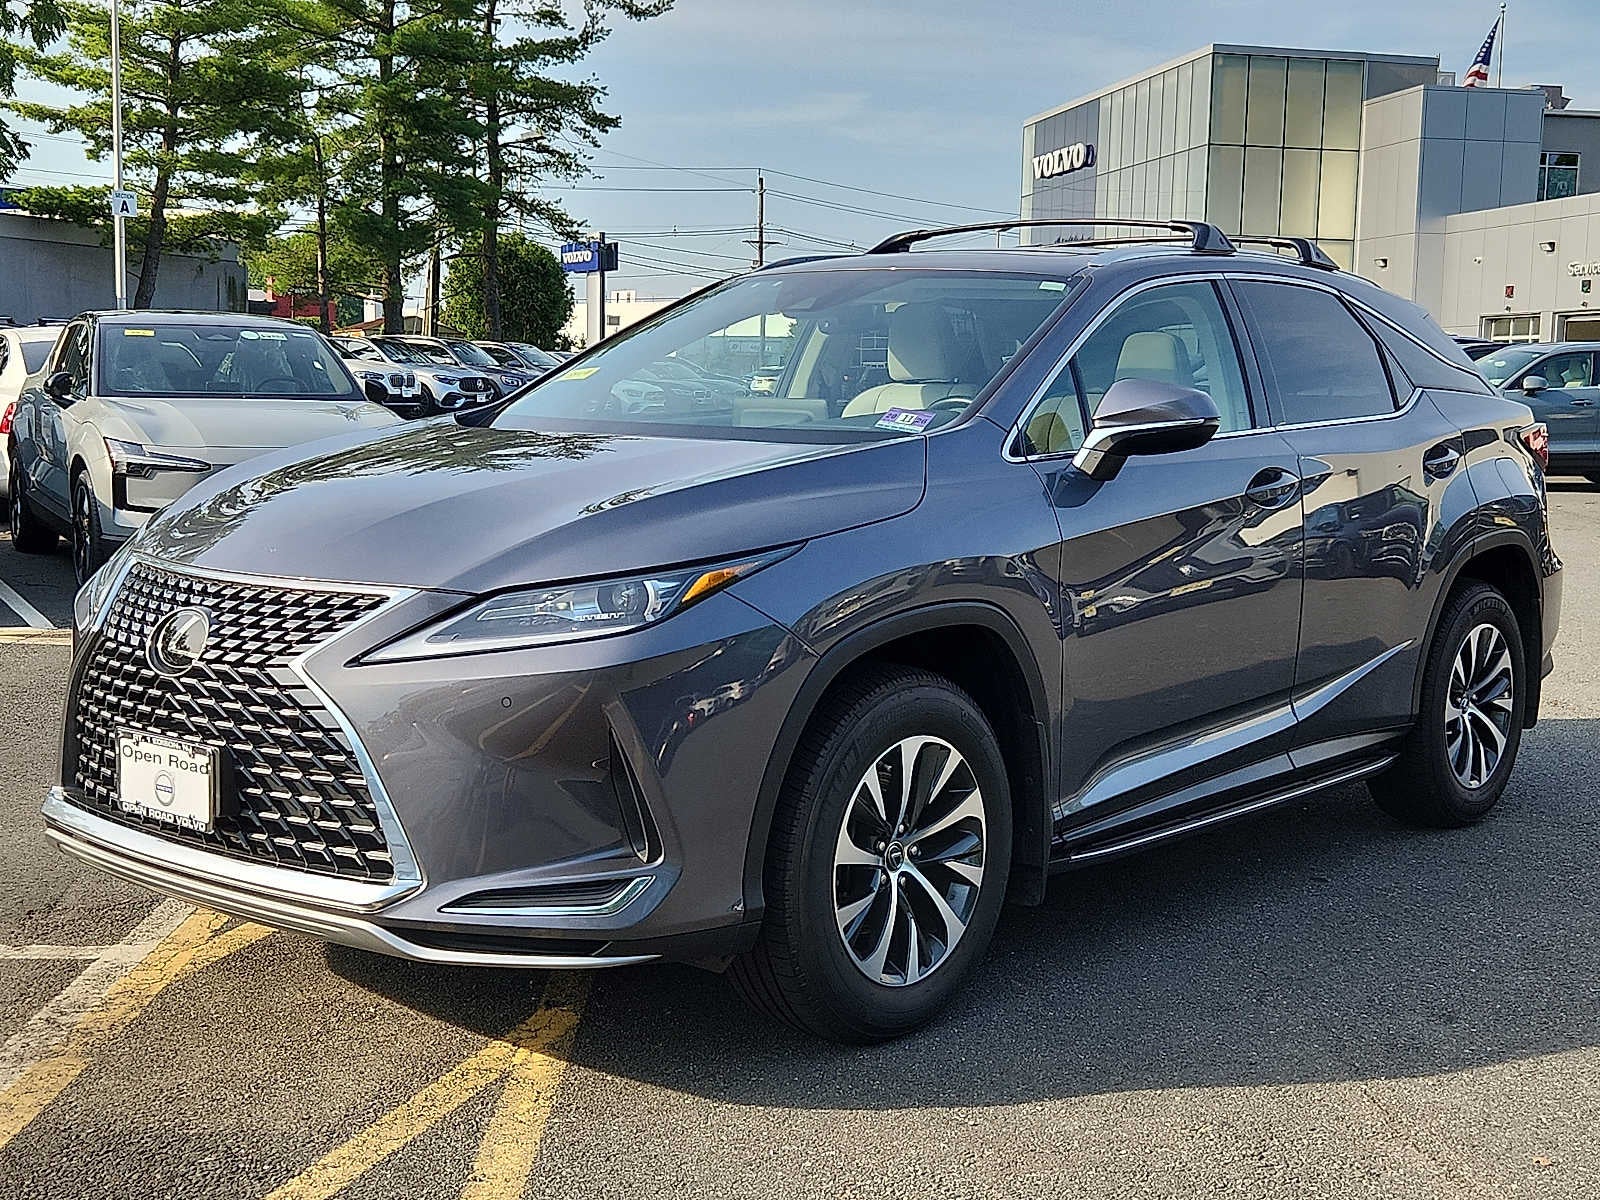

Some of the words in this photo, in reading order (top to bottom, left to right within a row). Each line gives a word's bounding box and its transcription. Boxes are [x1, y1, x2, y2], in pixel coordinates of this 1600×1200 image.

[1032, 142, 1086, 180] VOLVO
[120, 200, 130, 213] A
[562, 250, 592, 264] VOLVO
[900, 414, 915, 423] 11
[122, 744, 162, 764] Open
[168, 754, 209, 775] Road
[122, 801, 147, 817] OPEN
[148, 809, 175, 824] ROAD
[175, 815, 206, 832] VOLVO
